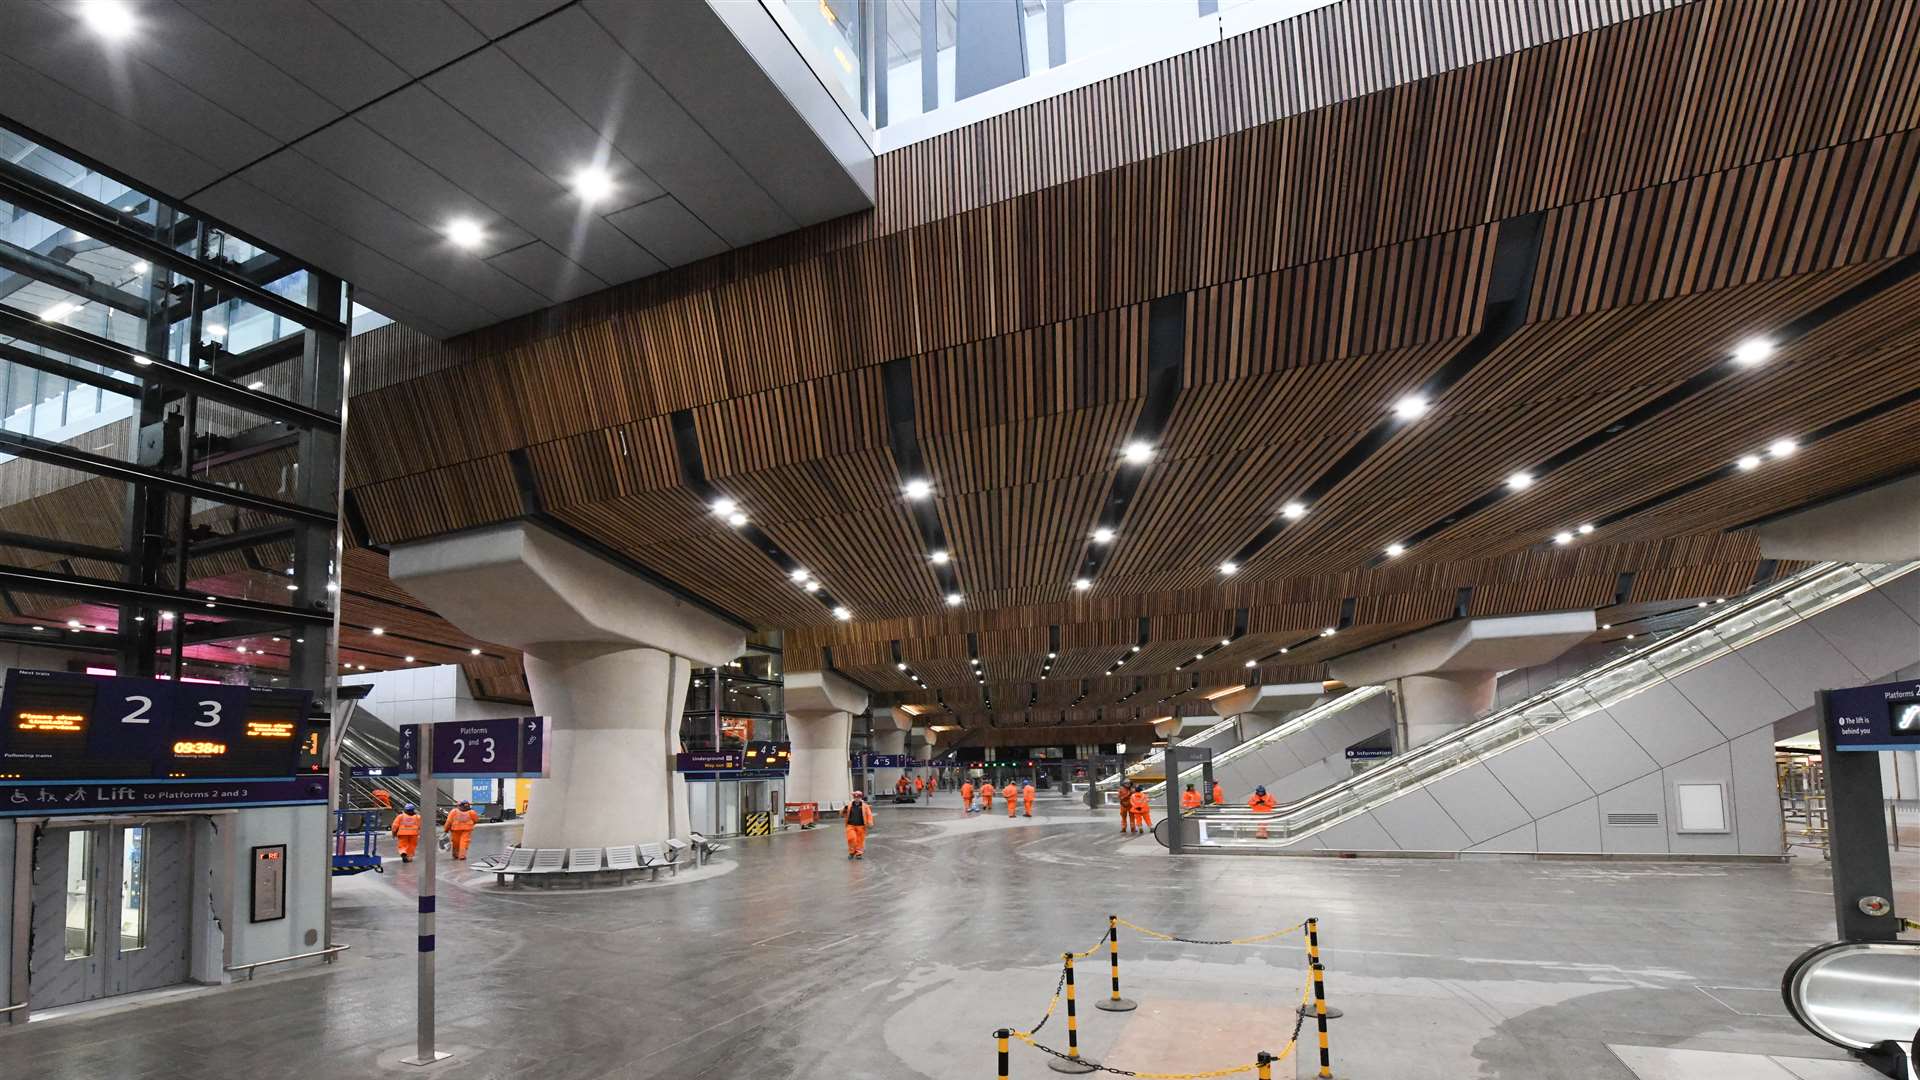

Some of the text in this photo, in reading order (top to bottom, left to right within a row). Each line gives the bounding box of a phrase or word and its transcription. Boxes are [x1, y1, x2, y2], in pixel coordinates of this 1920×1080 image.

[1884, 690, 1914, 699] Platforms
[121, 695, 152, 723] 2
[194, 701, 222, 727] 3
[460, 727, 488, 735] Platforms
[1841, 728, 1871, 737] behind you
[452, 737, 496, 764] 2 and 3
[760, 745, 767, 754] 4
[771, 745, 777, 754] 5
[98, 787, 136, 801] Lift
[158, 791, 209, 800] Platforms
[212, 790, 218, 798] 2
[221, 788, 239, 797] and
[242, 789, 248, 797] 3
